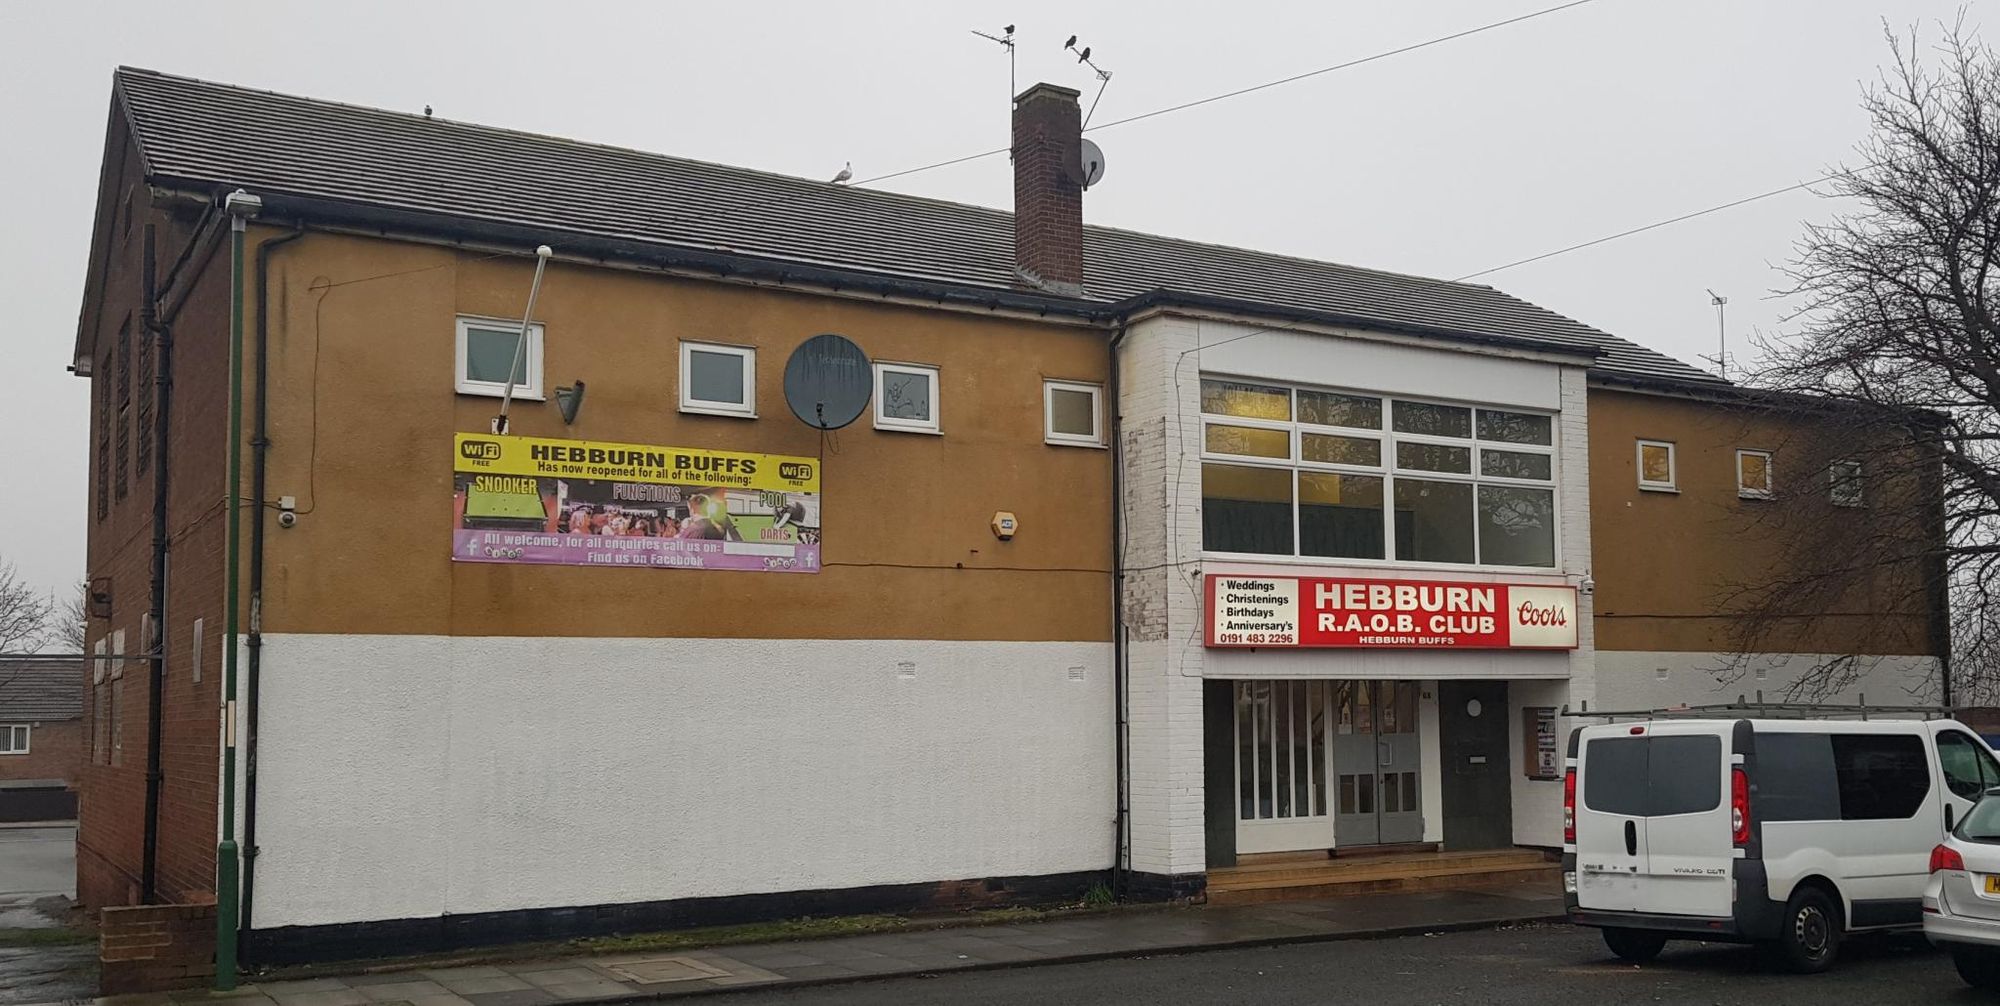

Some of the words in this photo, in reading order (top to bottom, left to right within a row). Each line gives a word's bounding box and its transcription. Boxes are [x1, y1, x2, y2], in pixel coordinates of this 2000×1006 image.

[463, 444, 500, 459] WiFi
[531, 444, 665, 468] HEBBURN
[675, 453, 757, 474] BUFFS
[538, 461, 558, 473] Has
[562, 465, 583, 474] now
[587, 465, 635, 479] reopened
[638, 468, 655, 478] for
[656, 469, 669, 479] all
[672, 469, 683, 480] of
[685, 470, 701, 481] the
[704, 472, 752, 487] following:
[781, 465, 811, 478] WiFi
[475, 475, 538, 496] SNOOKER
[612, 482, 682, 503] FUNCTIONS
[759, 491, 788, 508] POOL
[759, 527, 790, 541] DARTS
[484, 533, 500, 545] All
[504, 535, 563, 548] welcome,
[566, 536, 583, 547] for
[586, 537, 601, 548] all
[605, 538, 660, 552] enquiries
[663, 540, 685, 551] call
[687, 542, 701, 552] us
[703, 542, 721, 552] on:
[588, 552, 611, 563] Find
[615, 554, 631, 564] us
[633, 555, 648, 564] on
[650, 554, 704, 567] Facebook
[1226, 580, 1275, 592] Weddings
[1226, 594, 1289, 606] Christenings
[1315, 583, 1495, 613] HEBBURN
[1226, 607, 1275, 619] Birthdays
[1517, 600, 1567, 627] Coors
[1226, 620, 1293, 632] Anniversary's
[1318, 613, 1421, 634] R.A.O.B.
[1429, 615, 1495, 634] CLUB
[1220, 633, 1243, 643] 0191
[1246, 634, 1265, 643] 483
[1268, 634, 1293, 644] 2296
[1359, 636, 1415, 645] HEBBURN
[1418, 637, 1455, 645] BUFFS
